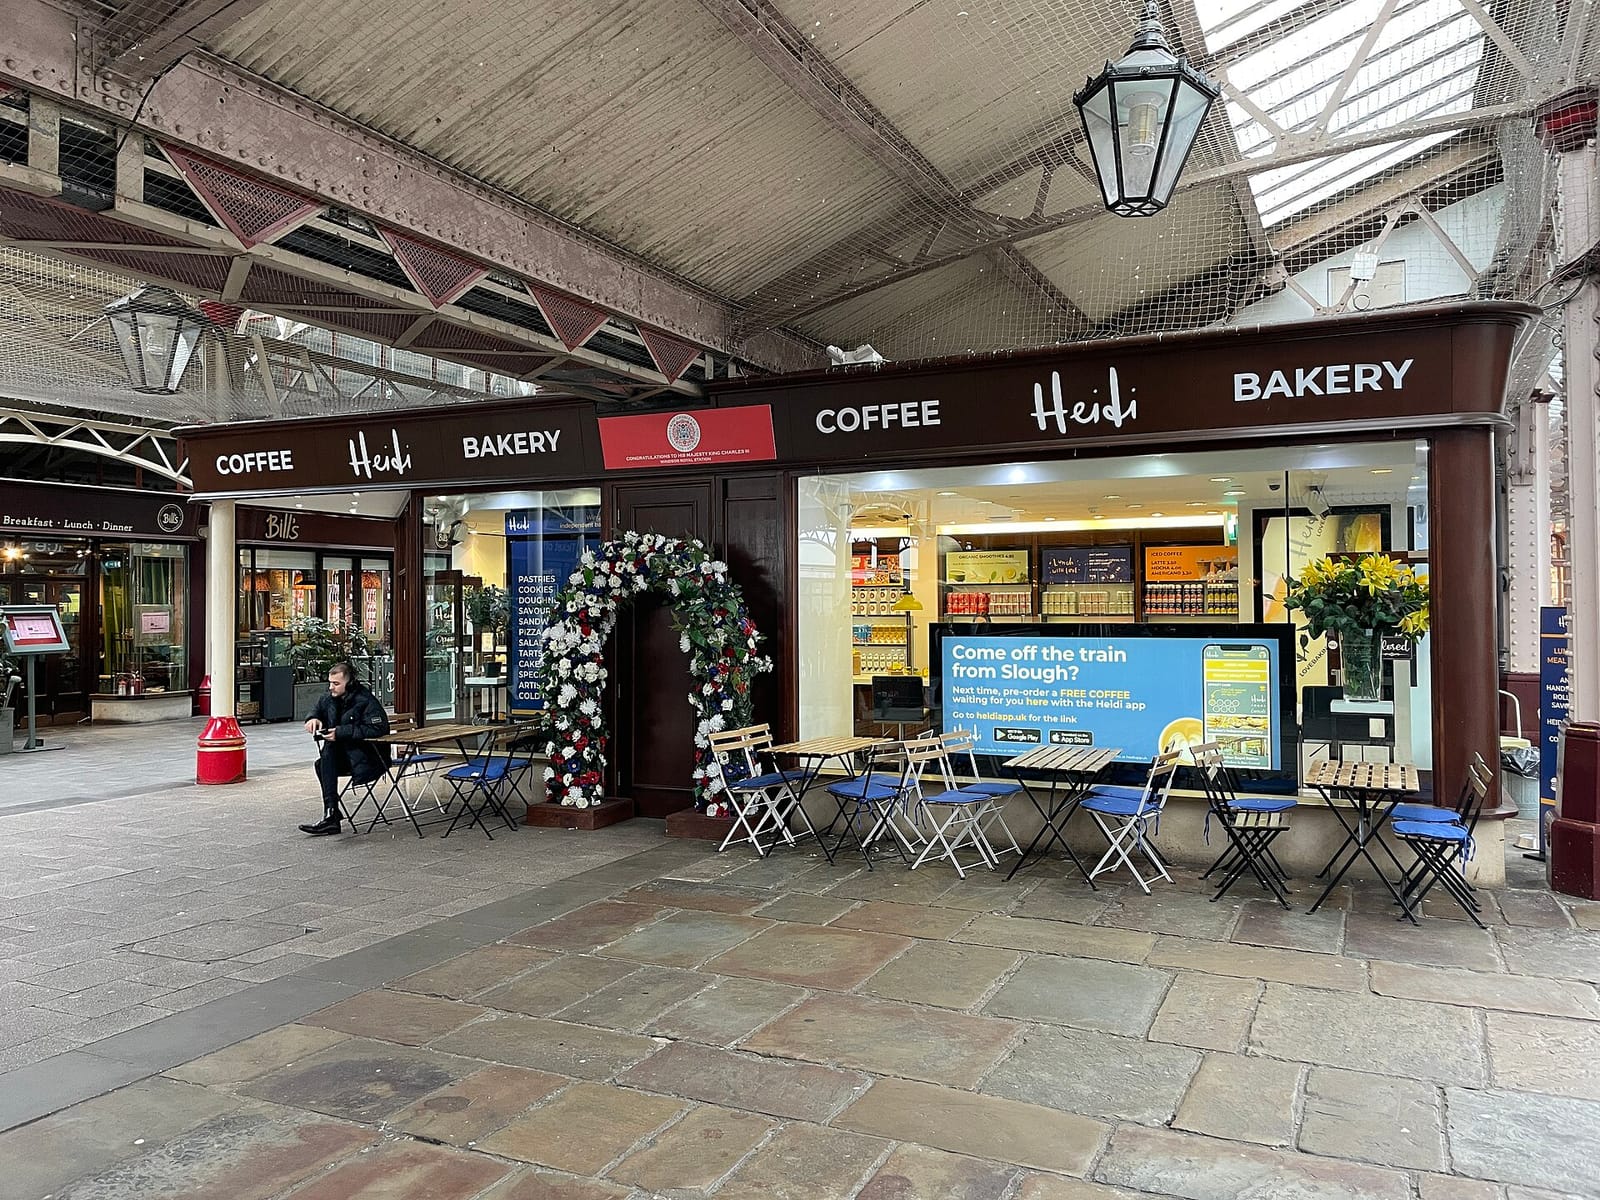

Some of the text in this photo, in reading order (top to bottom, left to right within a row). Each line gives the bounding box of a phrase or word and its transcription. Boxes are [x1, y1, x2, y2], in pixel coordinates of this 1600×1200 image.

[1234, 359, 1414, 402] BAKERY
[1030, 366, 1137, 435] Heidi
[815, 400, 941, 434] COFFEE
[462, 429, 561, 458] BAKERY
[216, 449, 294, 475] COFFEE
[348, 428, 412, 479] Heidi
[3, 516, 133, 532] Breakfast Lunch Dinner
[265, 513, 300, 540] Bill's
[508, 516, 530, 531] Heidi
[518, 616, 549, 626] SANDW
[952, 645, 1127, 662] Come off the train
[1382, 639, 1410, 652] losed
[1299, 646, 1328, 677] LOVEBAKIN
[952, 663, 1080, 684] from Slough?
[952, 686, 975, 695] Next
[976, 686, 1001, 696] time,
[1003, 688, 1050, 698] pre-order
[1060, 689, 1086, 698] FREE
[1088, 690, 1130, 700] COFFEE
[952, 696, 1146, 712] waiting for you here with the Heidi app
[976, 712, 1026, 723] heidiapp.uk
[1028, 714, 1042, 722] for
[1043, 714, 1058, 723] the
[1060, 715, 1078, 724] link
[1007, 734, 1038, 742] Google Play
